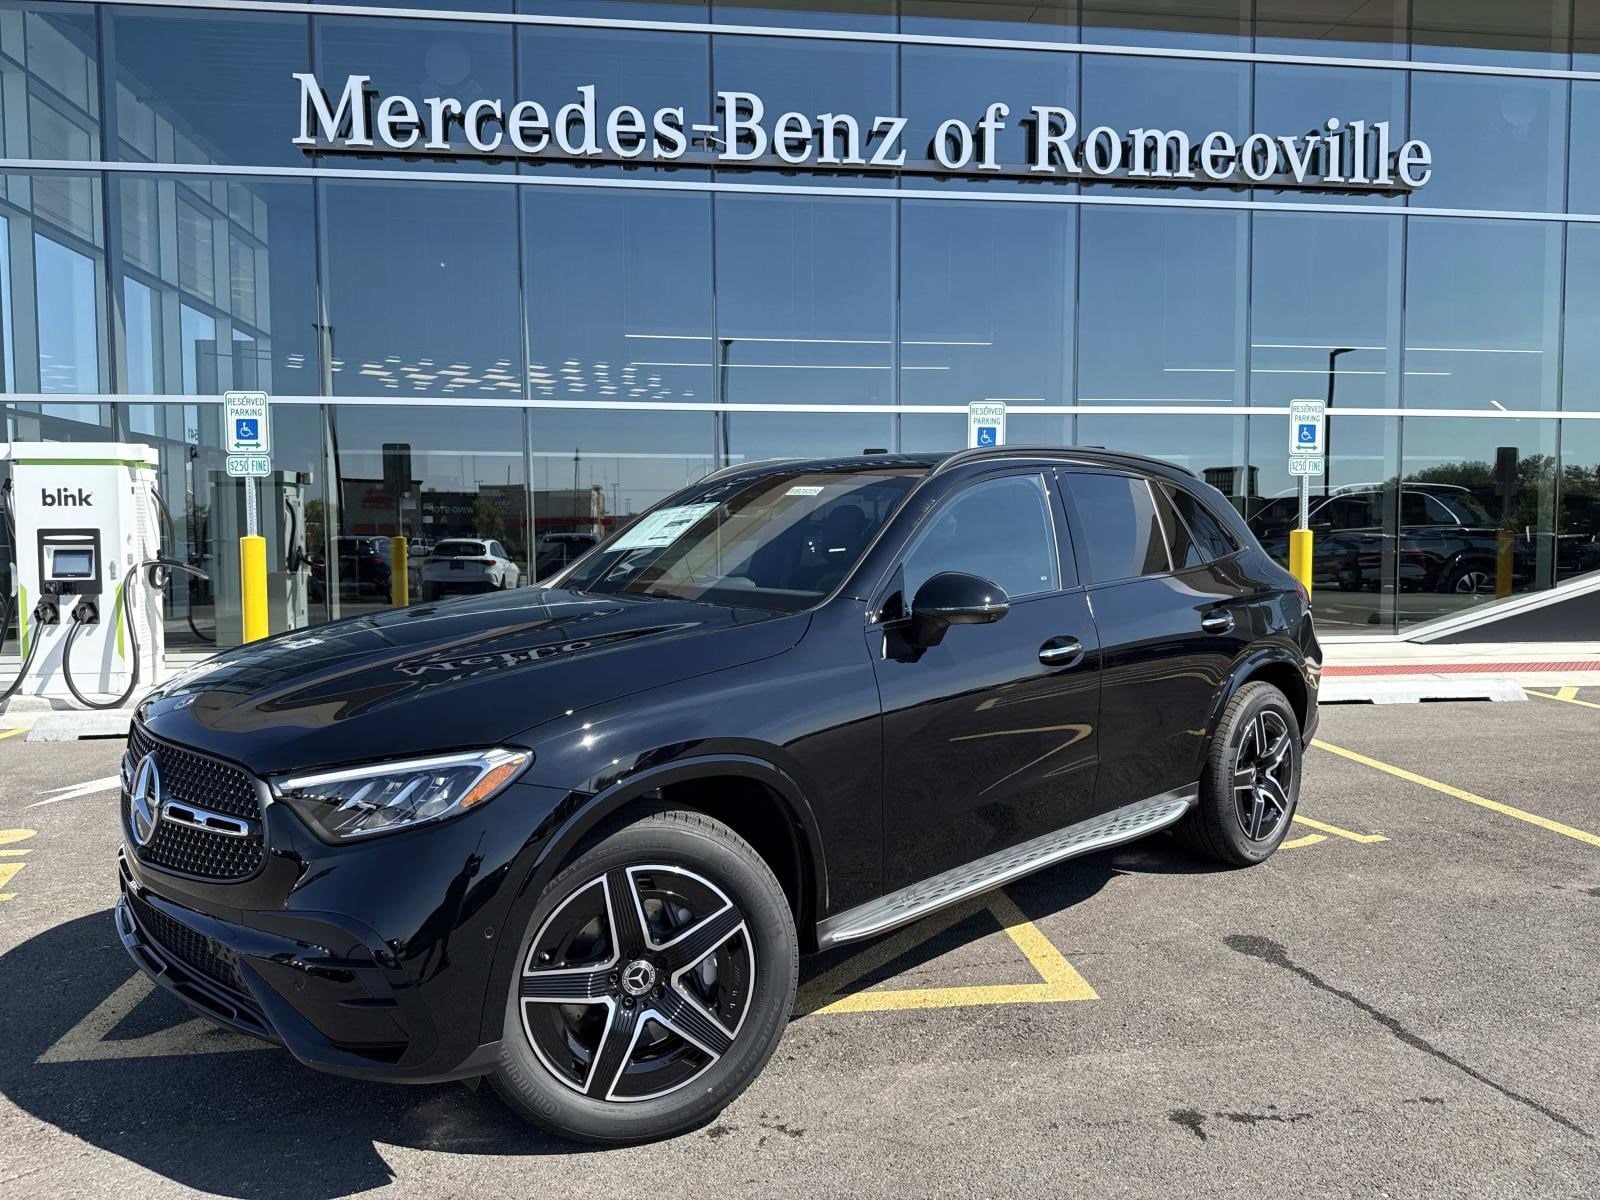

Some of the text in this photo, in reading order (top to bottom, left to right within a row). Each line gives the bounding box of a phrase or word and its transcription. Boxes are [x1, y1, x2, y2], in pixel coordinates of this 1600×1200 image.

[291, 72, 1433, 188] Mercedes-Benz of Romeoville
[227, 397, 265, 406] RESERVED
[230, 408, 263, 417] PARKING
[971, 407, 1003, 416] RESERVED
[1292, 405, 1323, 413] RESERVED
[973, 417, 1001, 425] PARKING
[1294, 414, 1321, 422] PARKING
[230, 460, 267, 472] $250 FINE
[1292, 460, 1321, 472] $250 FINE
[41, 487, 94, 507] blink
